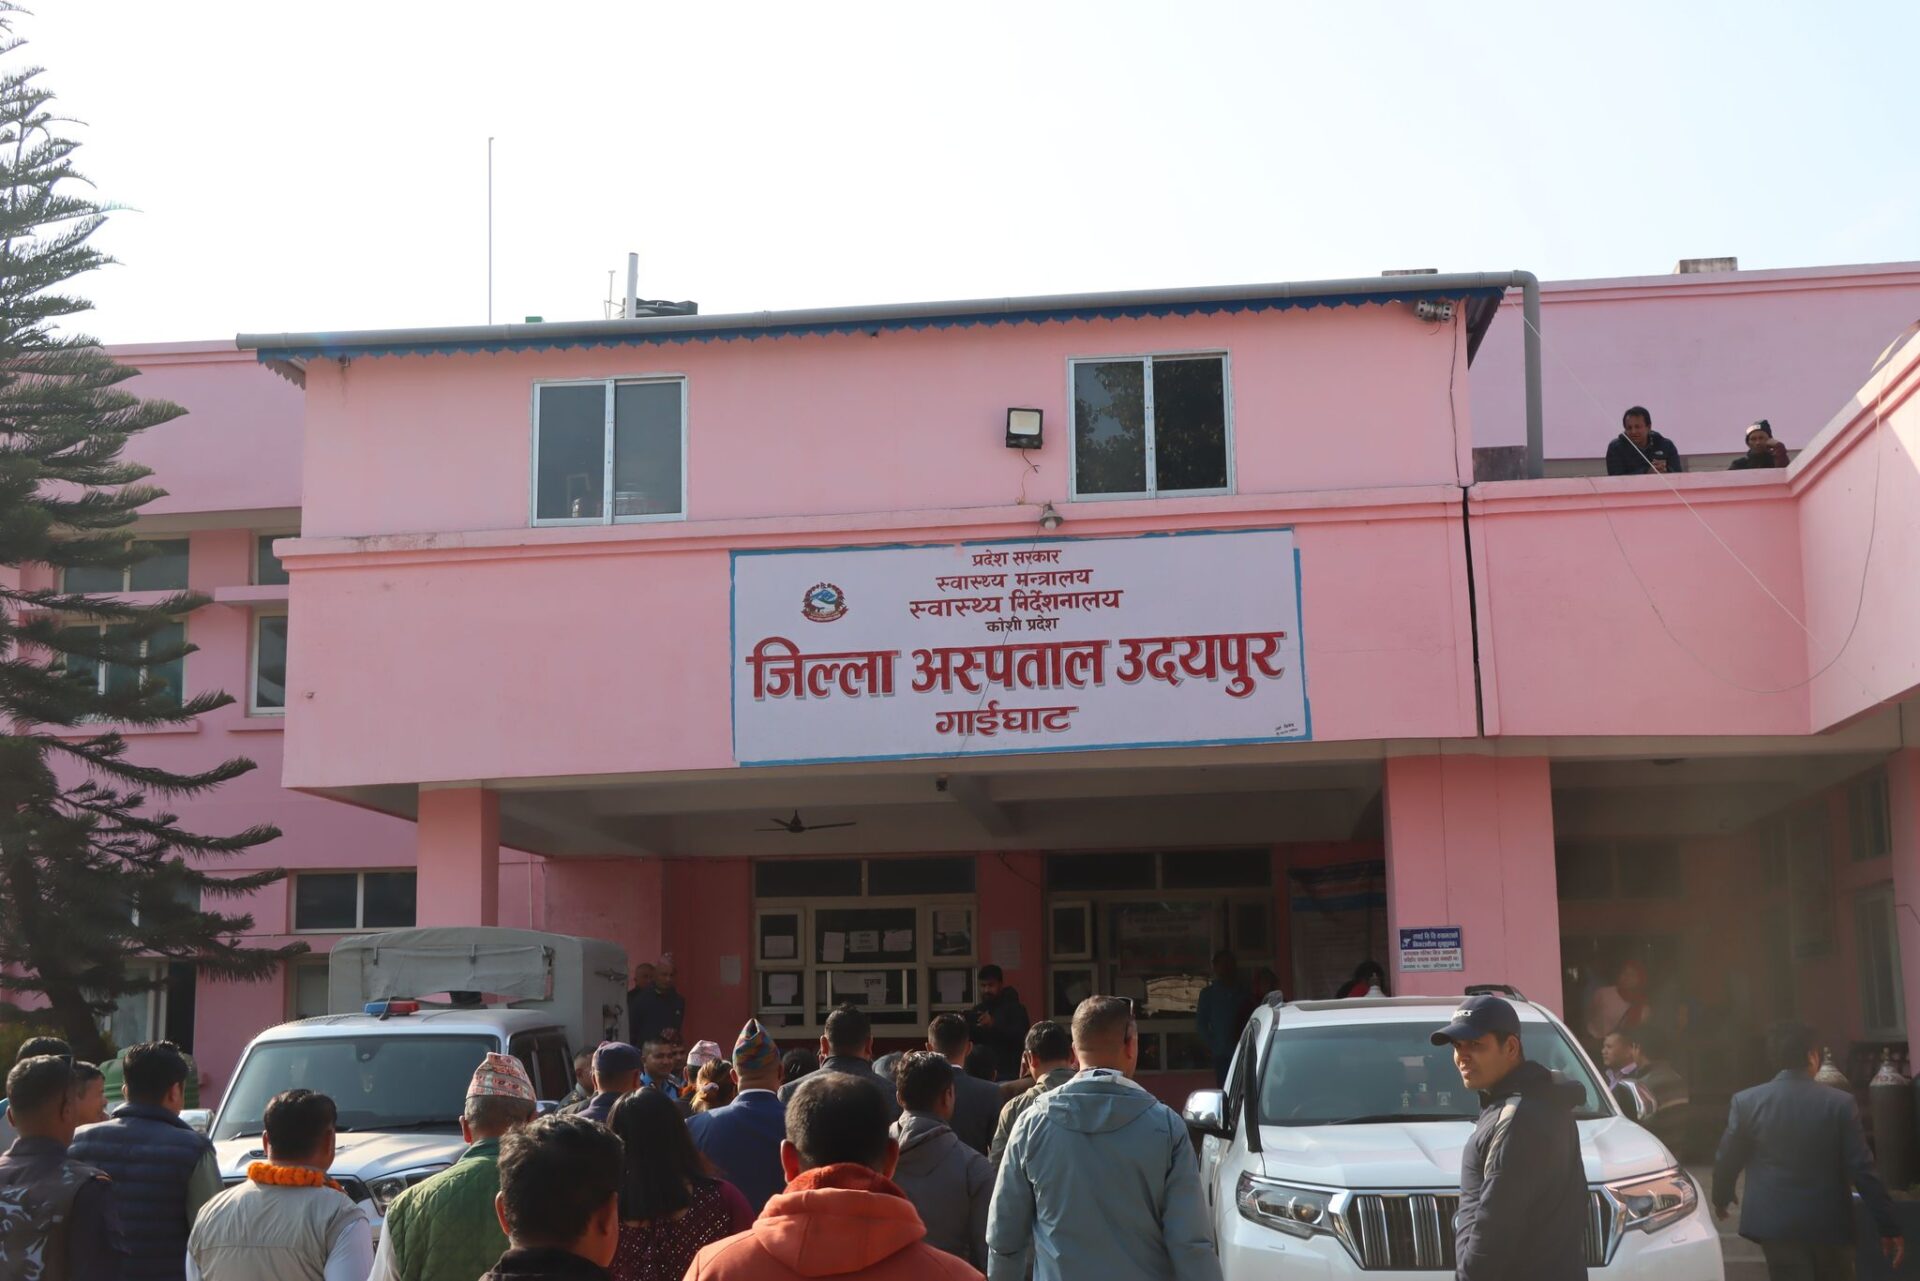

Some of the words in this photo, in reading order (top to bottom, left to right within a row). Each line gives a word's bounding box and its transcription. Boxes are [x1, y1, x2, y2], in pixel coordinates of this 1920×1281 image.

[972, 549, 1009, 567] प्रदेश
[1013, 549, 1062, 566] सरकार
[936, 574, 1008, 592] स्वास्थ्य
[1015, 569, 1094, 587] मन्त्रालय
[910, 597, 1003, 619] स्वास्थ्य
[1009, 589, 1124, 613] निर्देशनालय
[985, 615, 1022, 633] कोशी
[1026, 615, 1060, 631] प्रदेश
[746, 637, 900, 700] जिल्ला
[912, 639, 1110, 695] अस्पताल
[1117, 631, 1285, 698] उदयपुर
[936, 700, 1079, 737] गाईघाट
